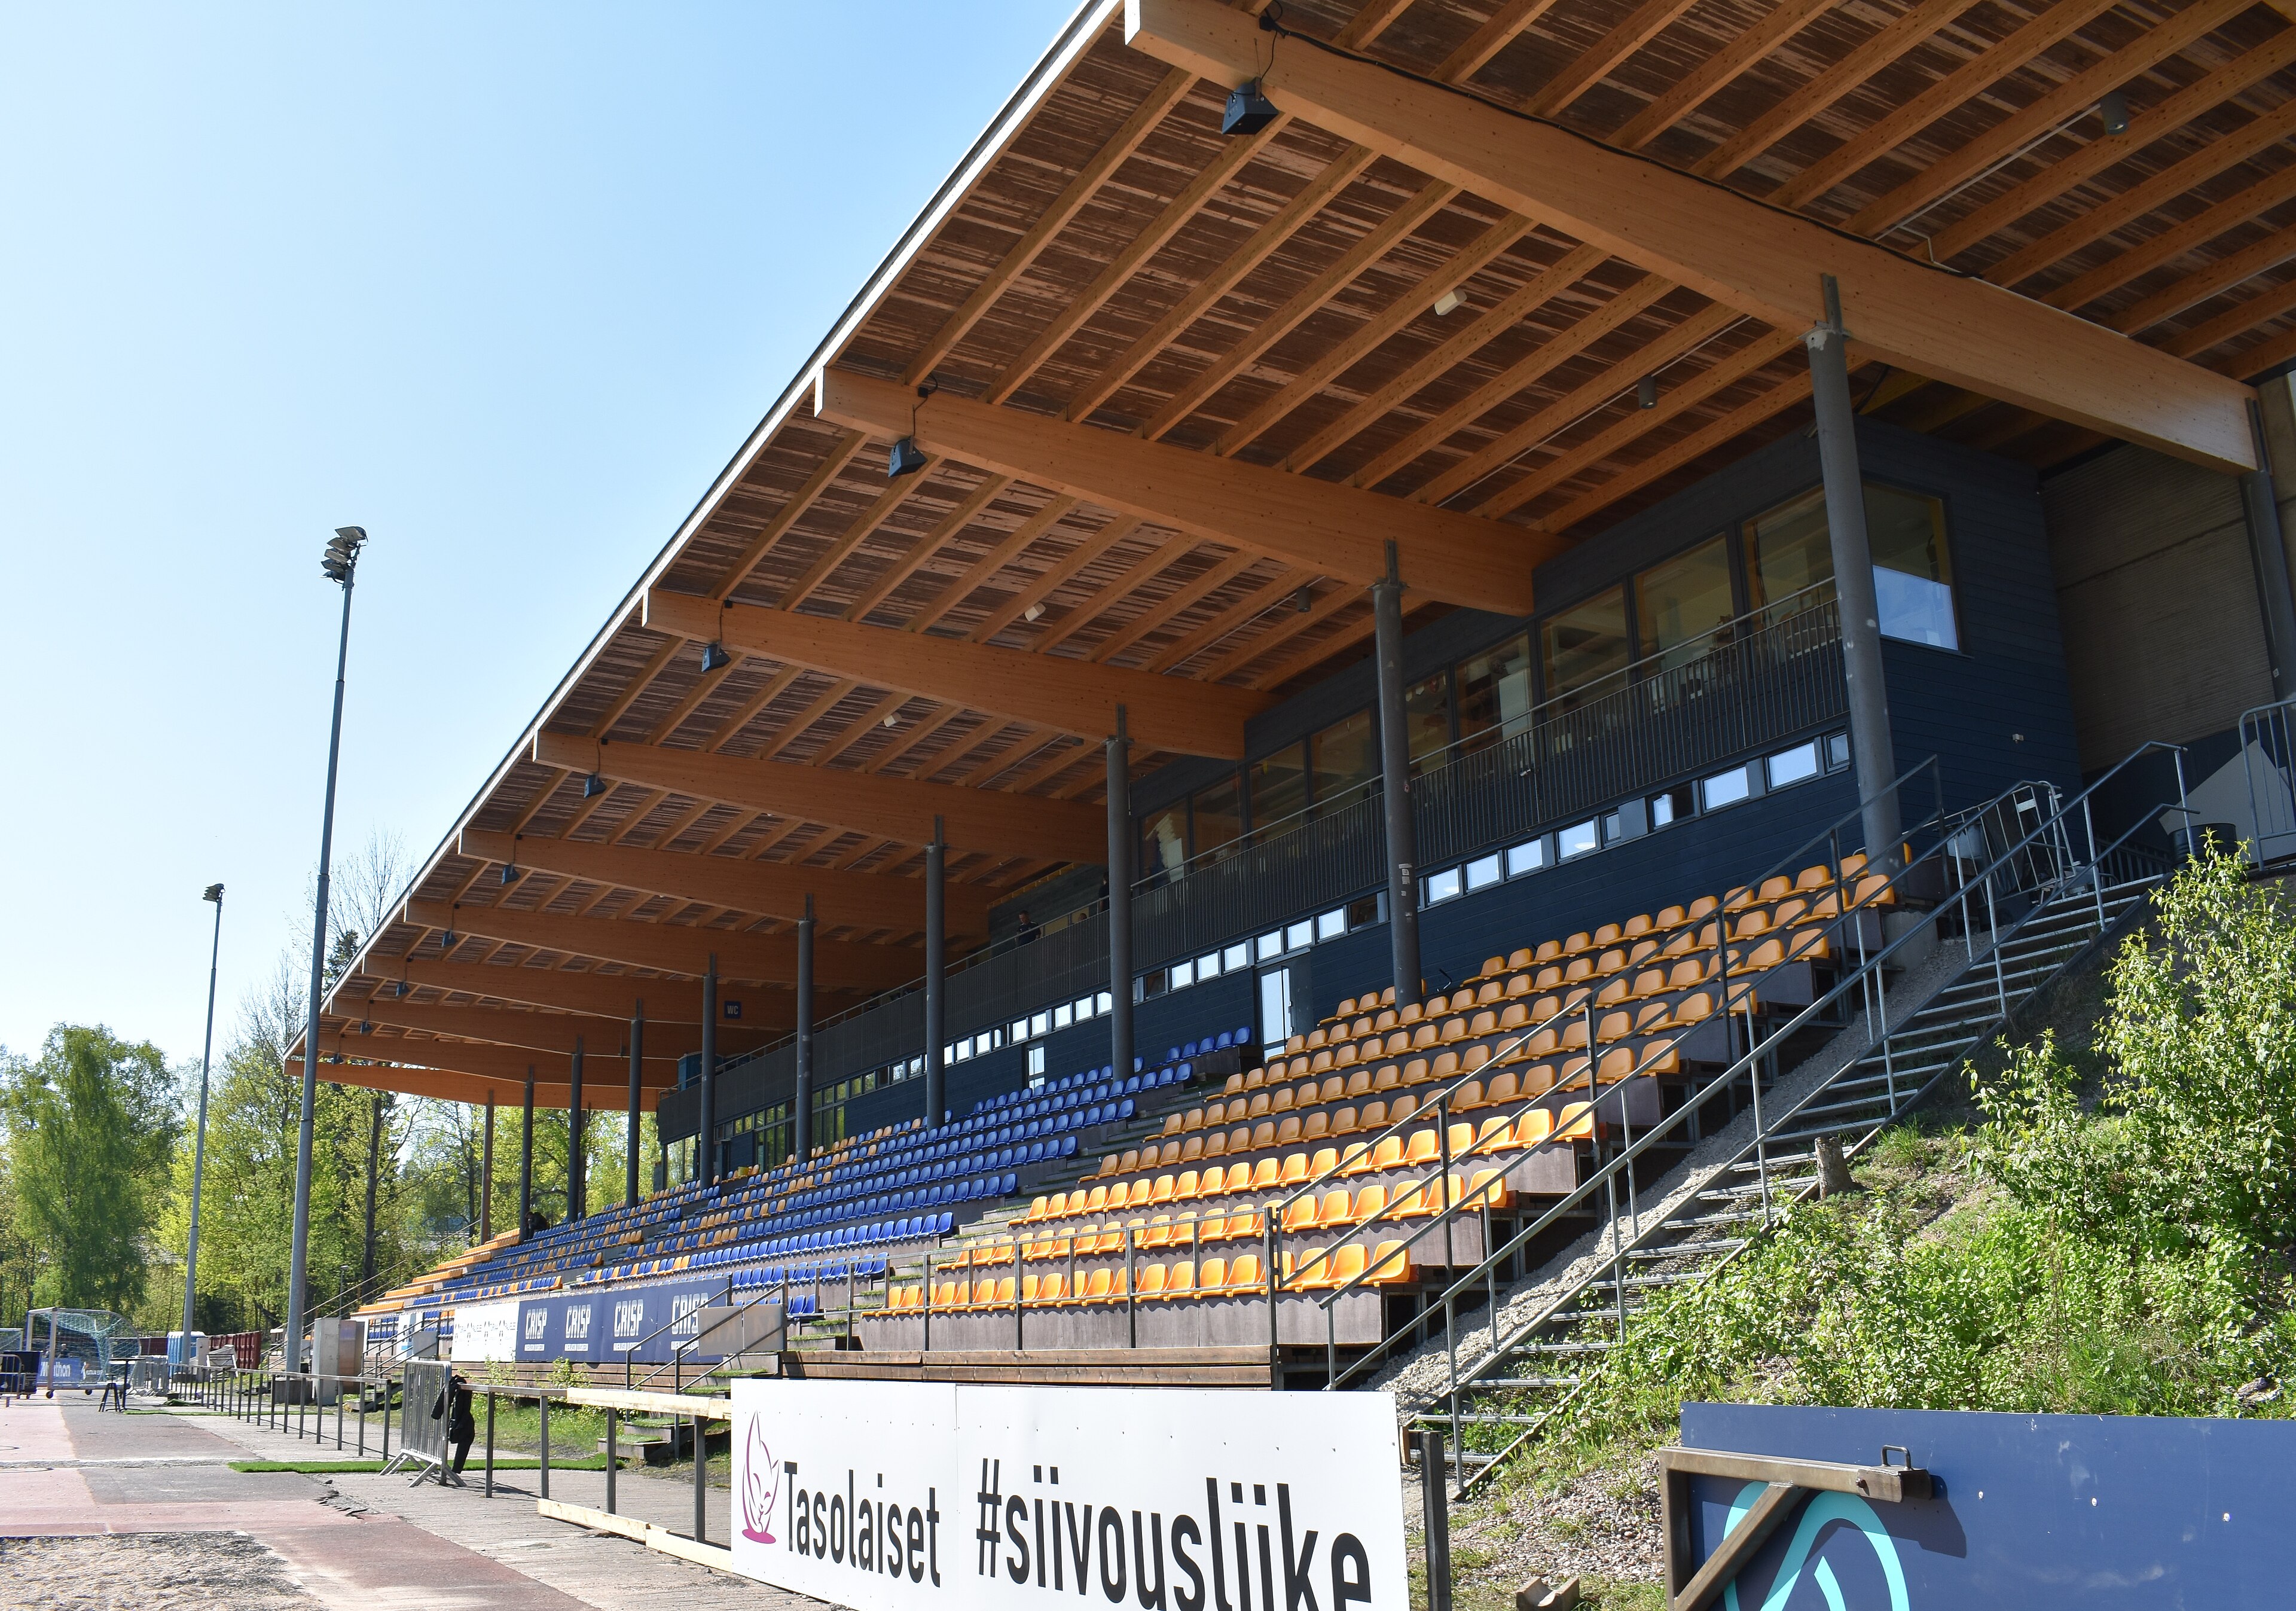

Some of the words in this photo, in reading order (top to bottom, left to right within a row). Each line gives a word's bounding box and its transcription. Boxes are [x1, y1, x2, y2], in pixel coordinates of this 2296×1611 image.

[727, 1005, 738, 1015] WC
[525, 1307, 548, 1340] CRISP
[565, 1304, 591, 1339] CRISP
[613, 1298, 644, 1338] CRISP
[784, 1462, 941, 1588] Tasolaiset
[976, 1458, 1372, 1611] #siivousliike
